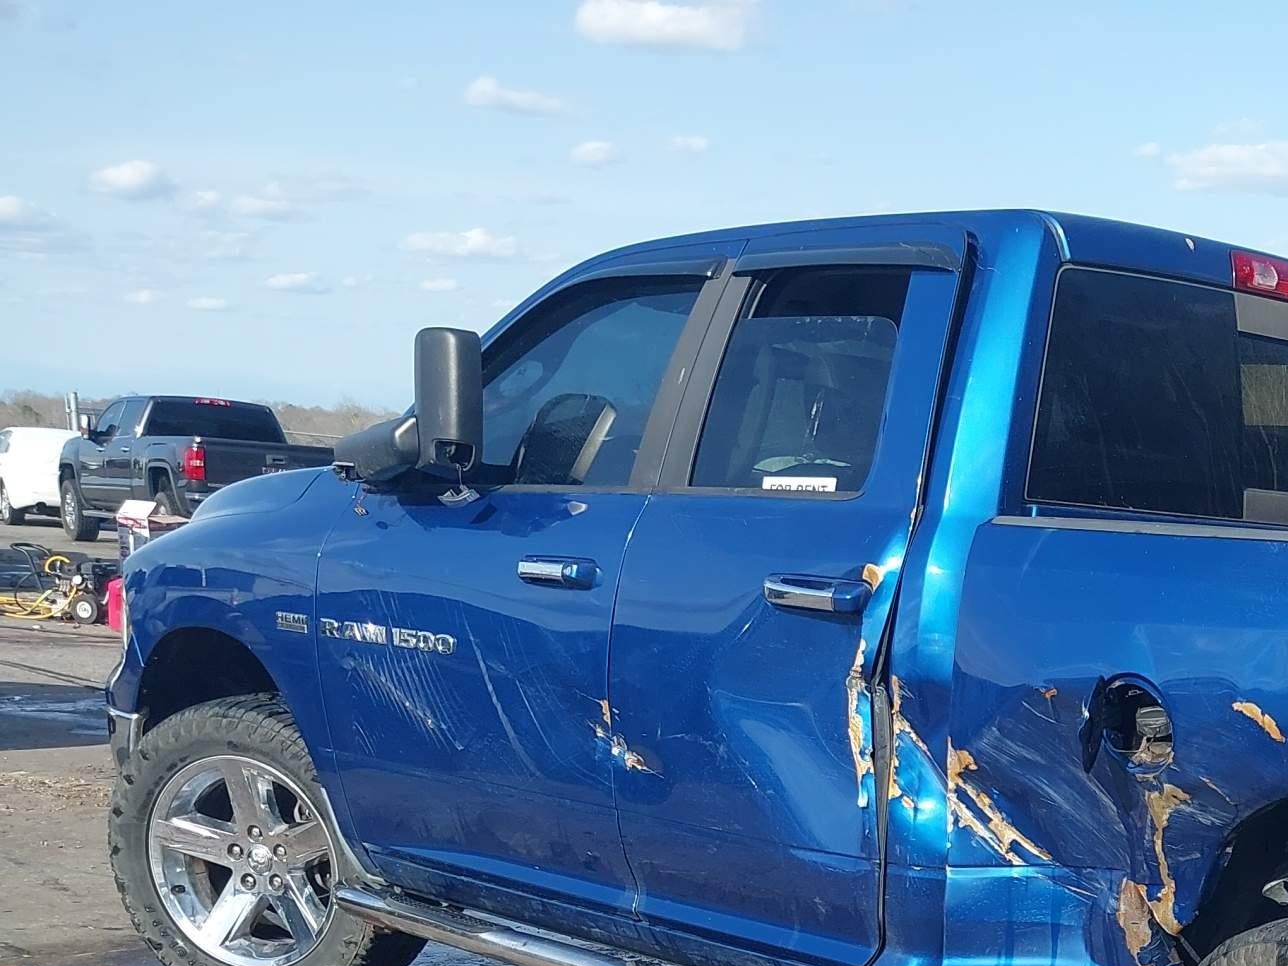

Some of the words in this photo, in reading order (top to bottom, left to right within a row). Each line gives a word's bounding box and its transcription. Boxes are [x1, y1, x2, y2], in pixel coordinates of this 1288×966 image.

[275, 611, 308, 625] HEMI
[319, 617, 387, 645] RAM
[391, 627, 457, 655] 1500
